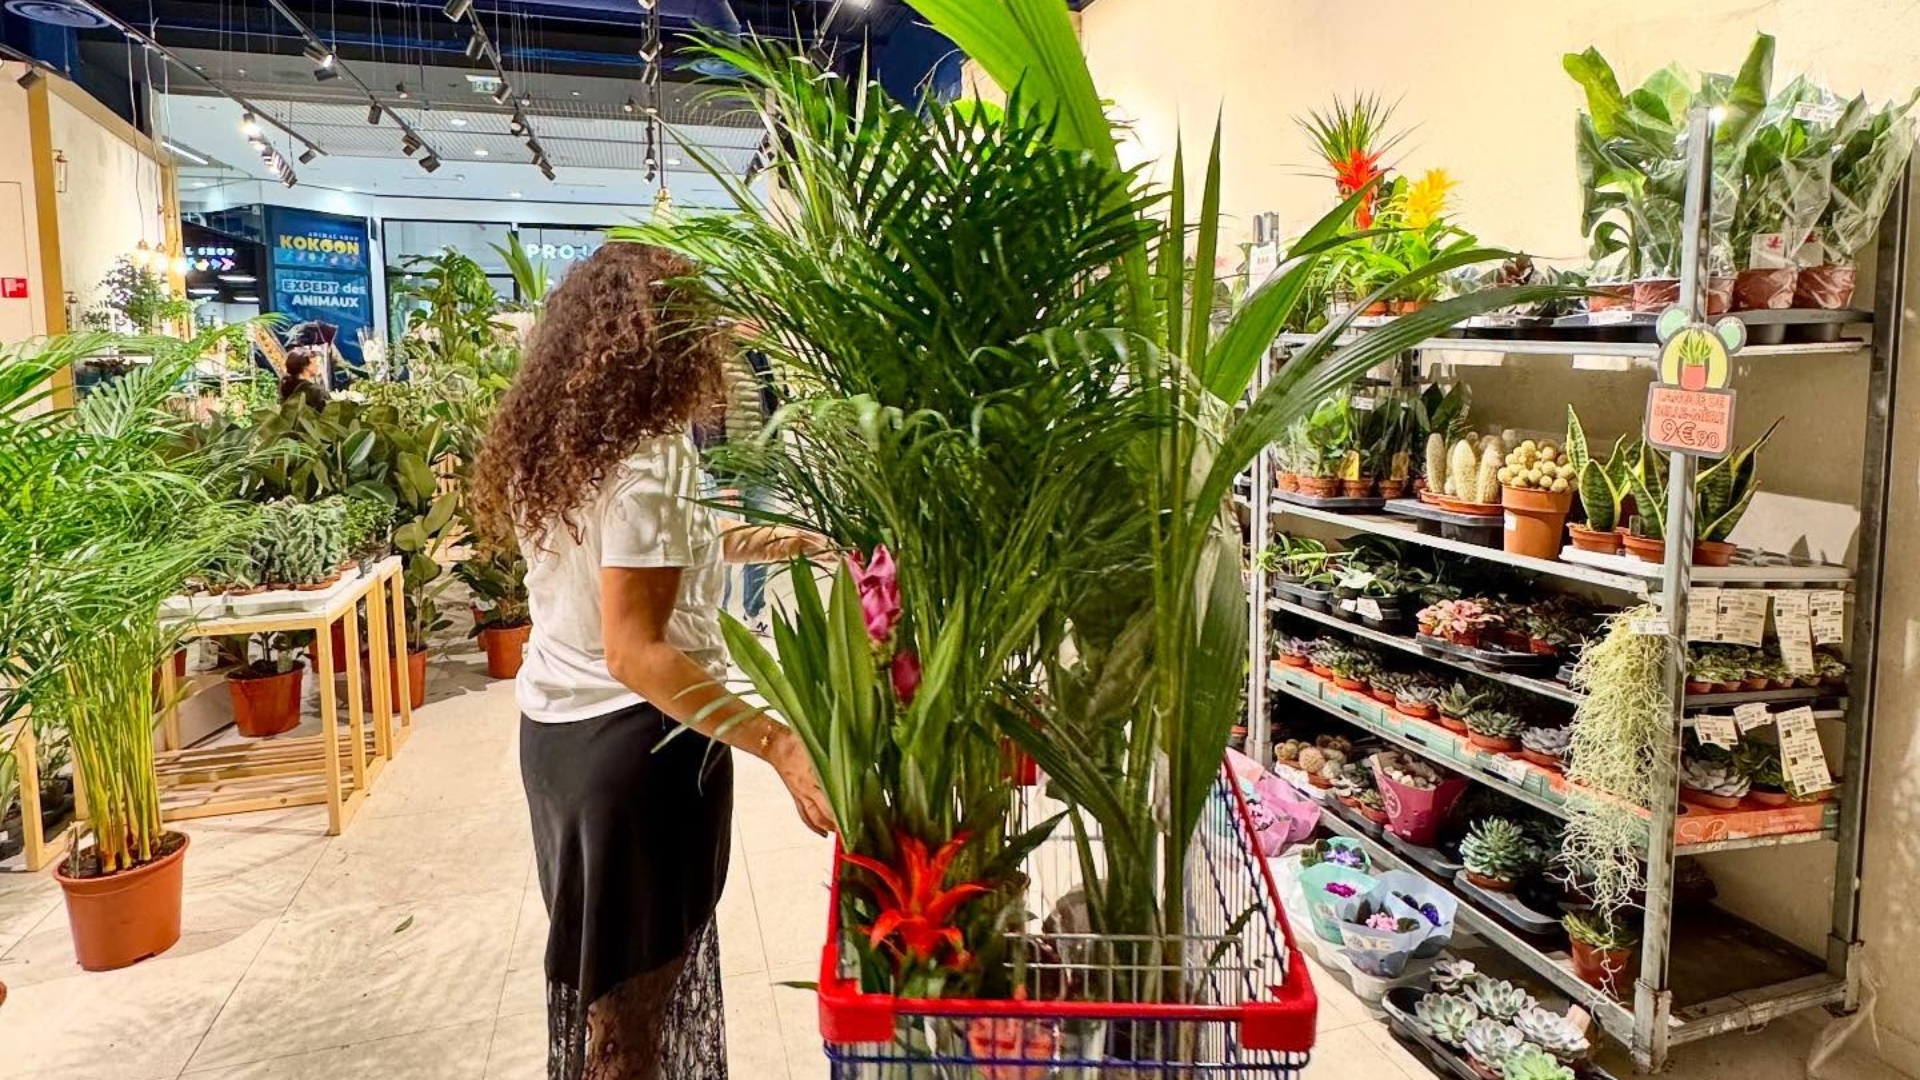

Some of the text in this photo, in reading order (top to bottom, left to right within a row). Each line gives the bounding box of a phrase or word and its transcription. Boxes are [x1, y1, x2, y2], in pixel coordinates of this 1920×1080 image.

[198, 247, 235, 256] SHOP
[280, 235, 359, 255] KOKOON
[283, 280, 366, 295] EXPERT des
[291, 295, 359, 308] ANIMAUX
